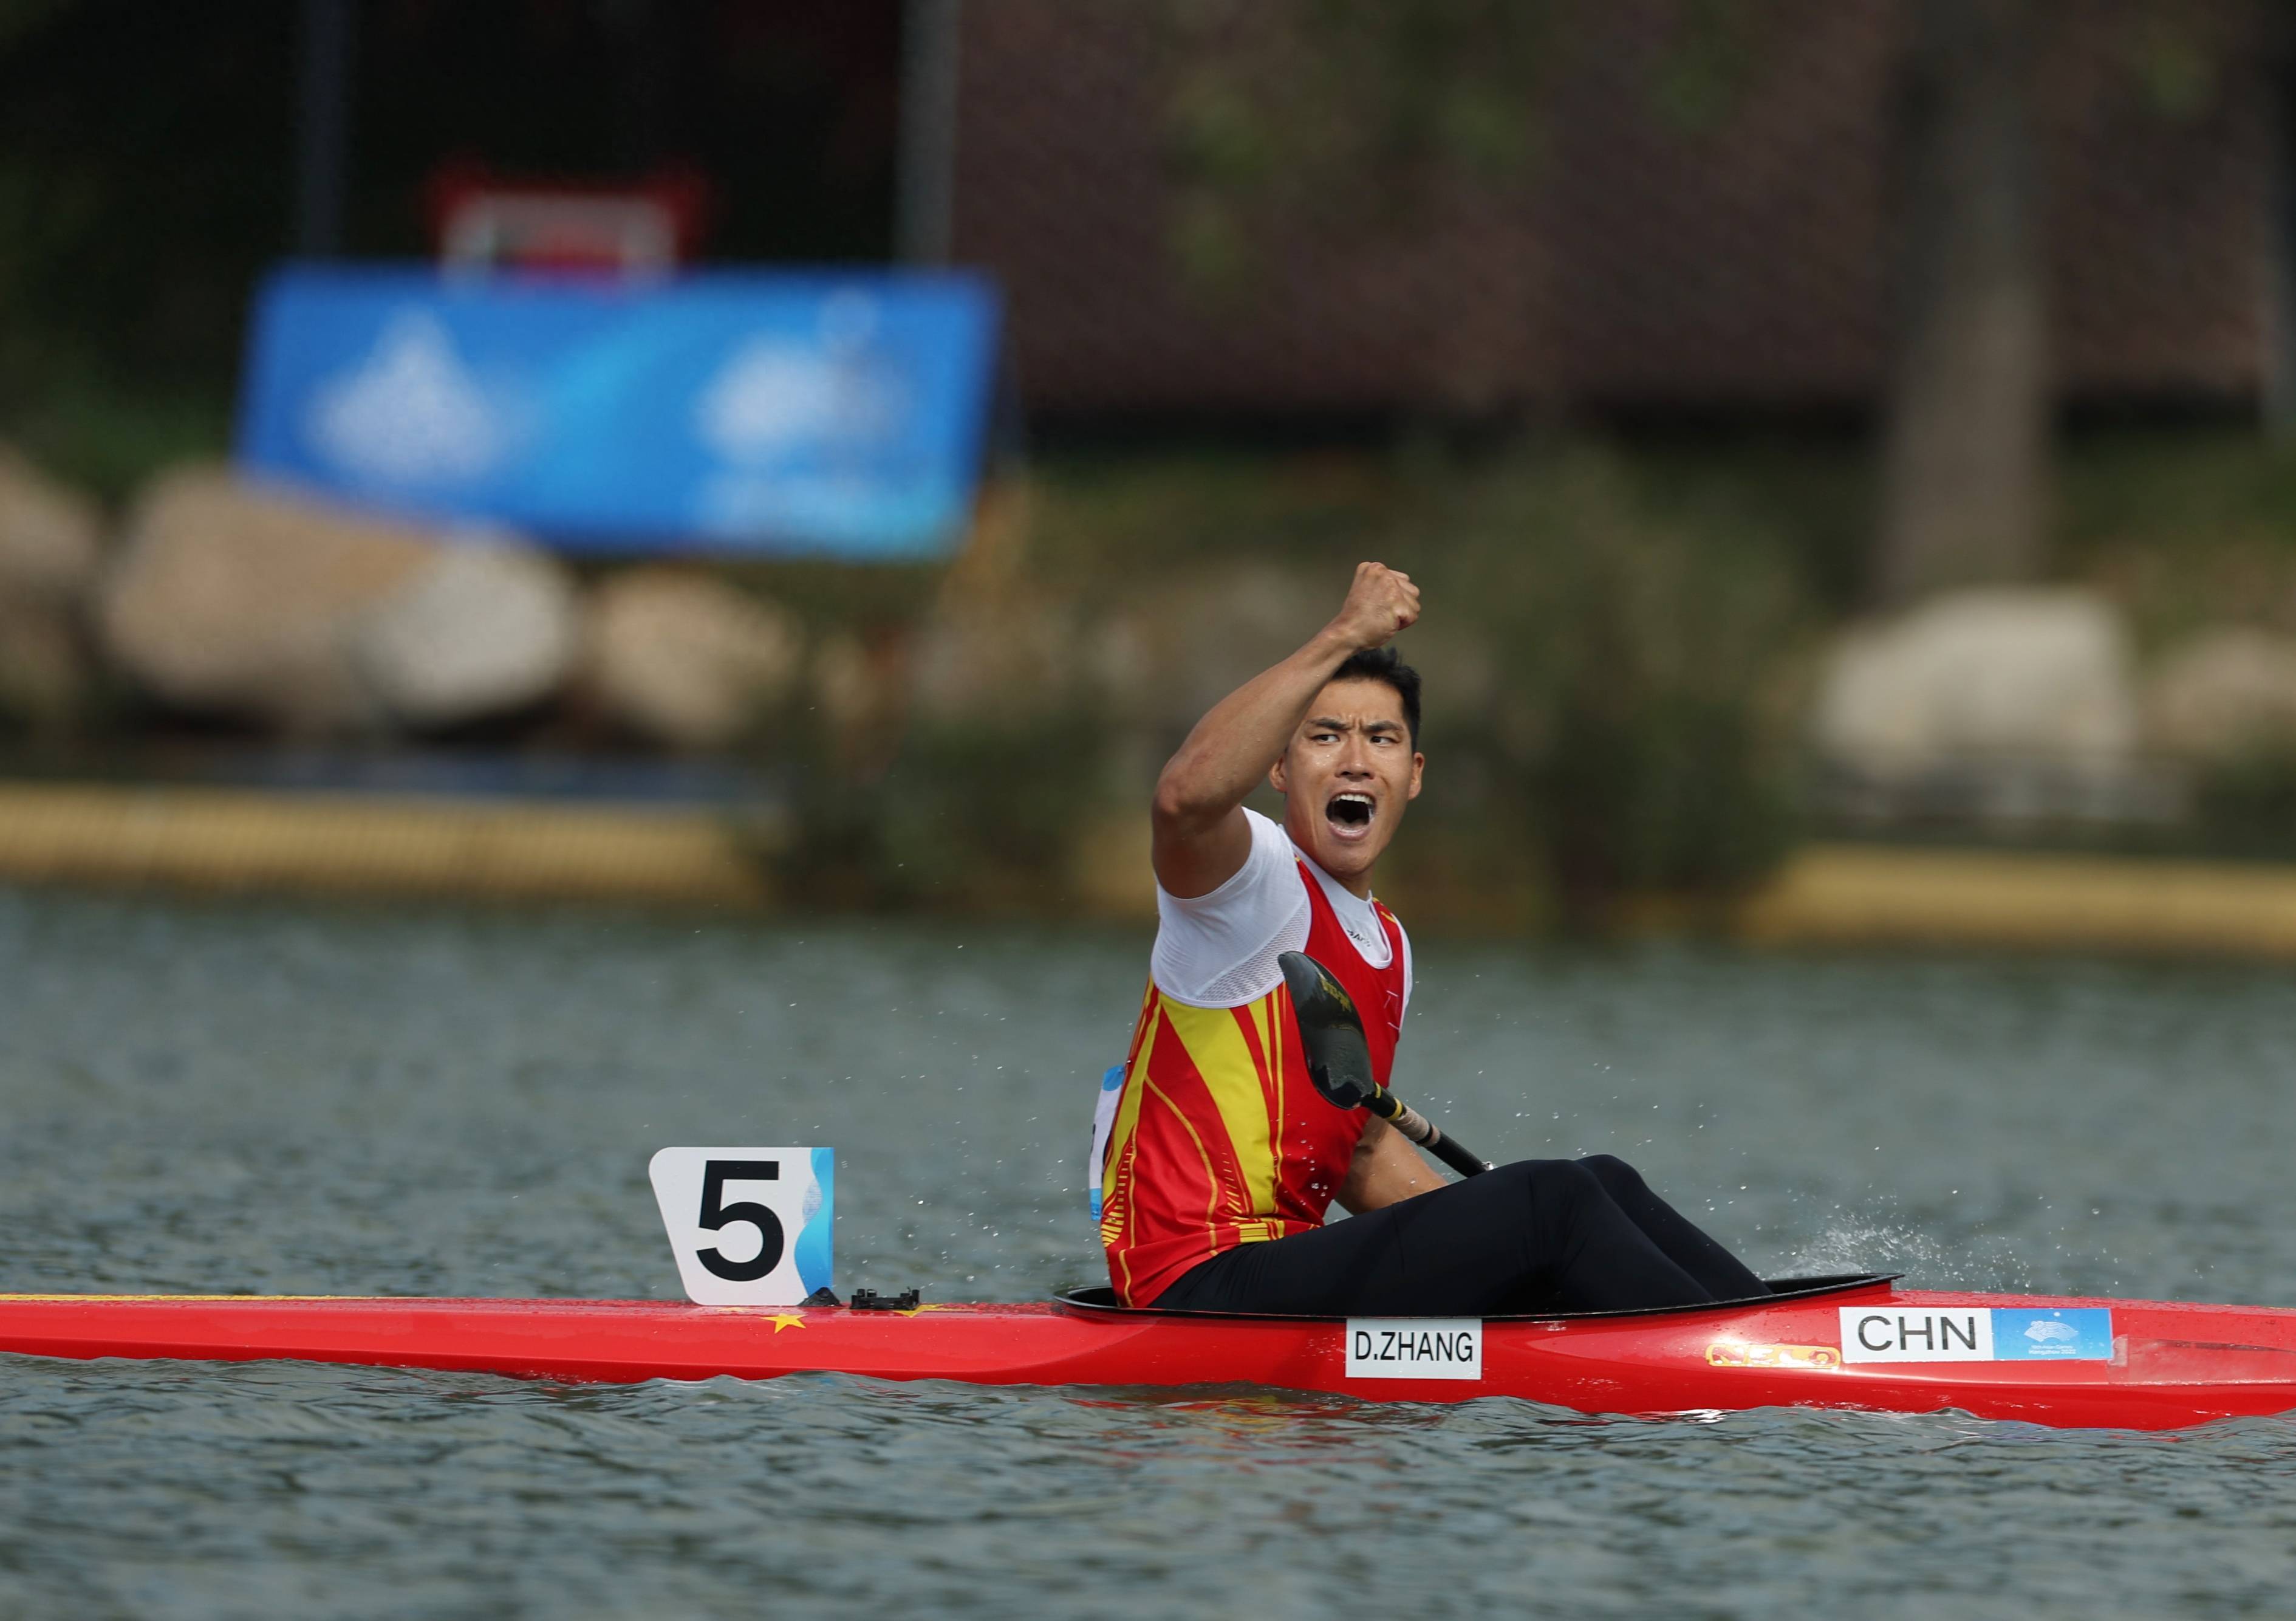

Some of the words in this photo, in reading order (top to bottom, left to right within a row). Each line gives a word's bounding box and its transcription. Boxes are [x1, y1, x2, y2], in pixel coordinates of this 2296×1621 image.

[696, 1160, 785, 1281] 5
[1355, 1331, 1473, 1362] D.ZHANG
[1858, 1315, 1977, 1351] CHN
